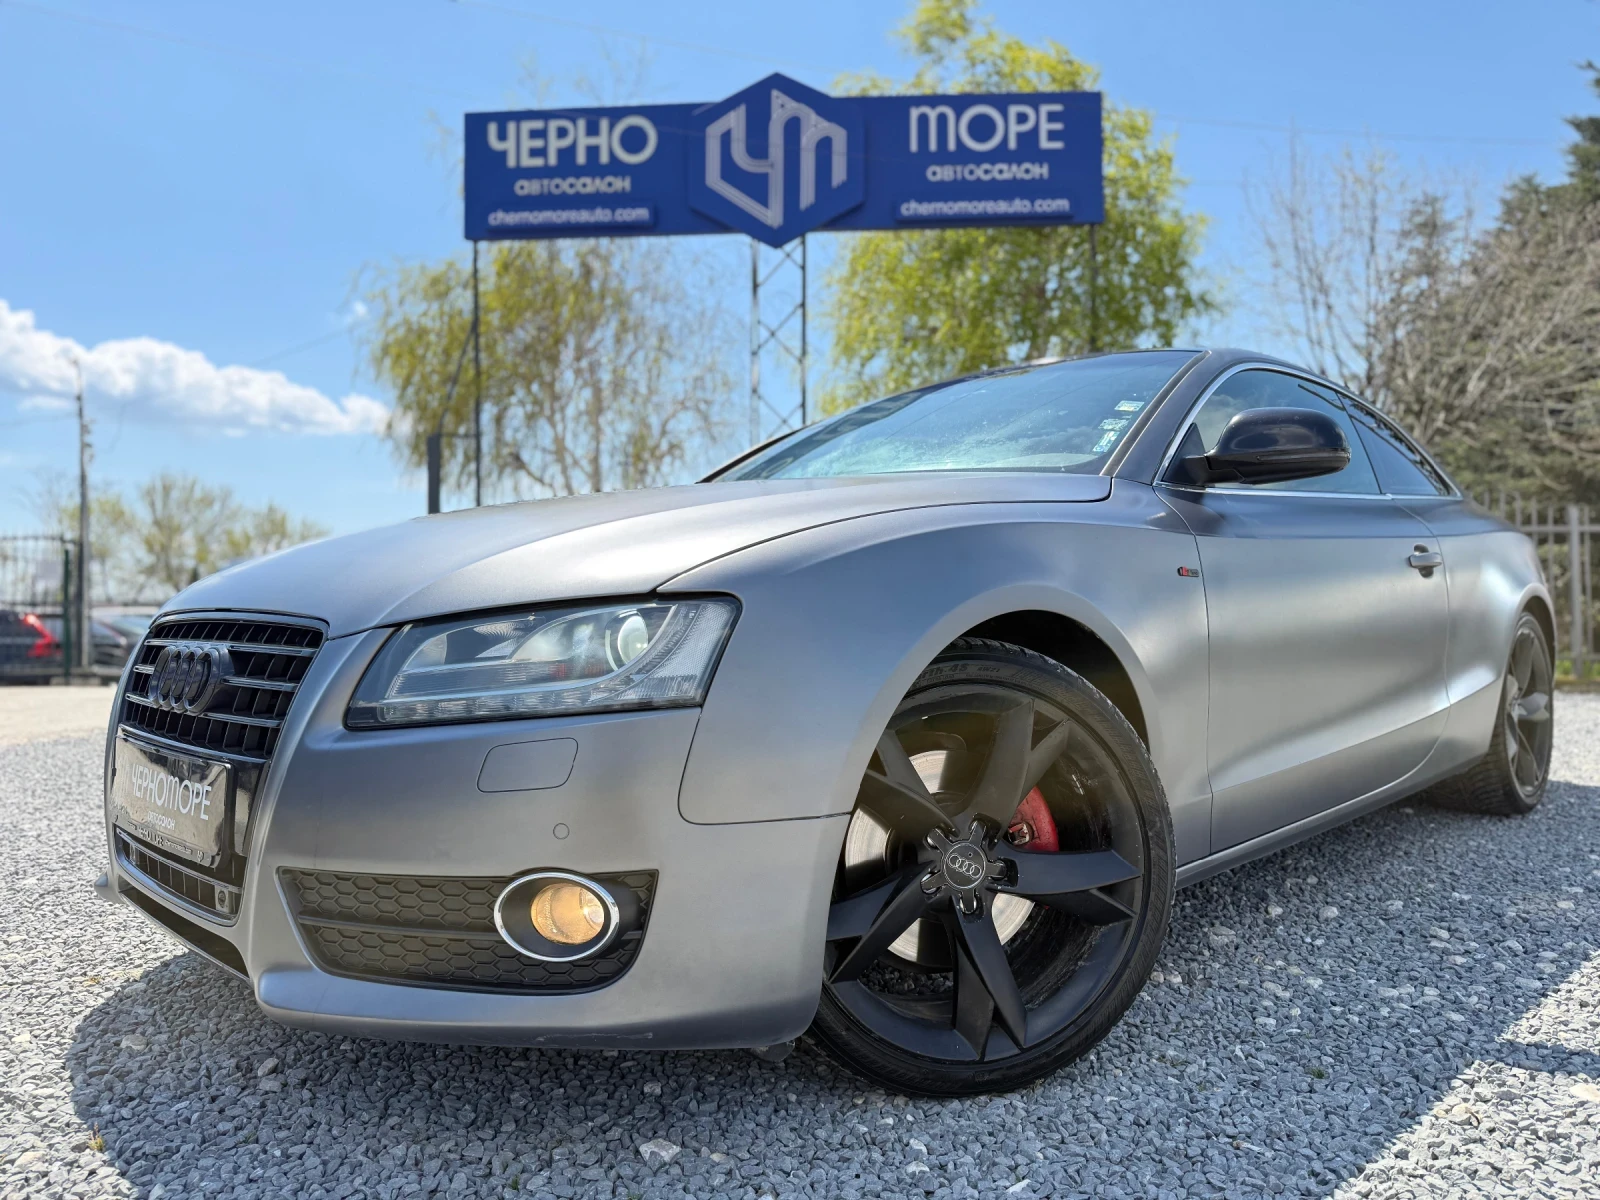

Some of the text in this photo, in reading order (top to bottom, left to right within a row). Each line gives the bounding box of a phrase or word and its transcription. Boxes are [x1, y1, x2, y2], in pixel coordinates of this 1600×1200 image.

[487, 115, 658, 168] ЧЕРНО
[909, 104, 1065, 152] МОРЕ
[488, 206, 650, 226] chernomoreauto.com
[900, 198, 1070, 216] chernomoreauto.com
[132, 764, 212, 821] ЧЕРНОМОРЕ
